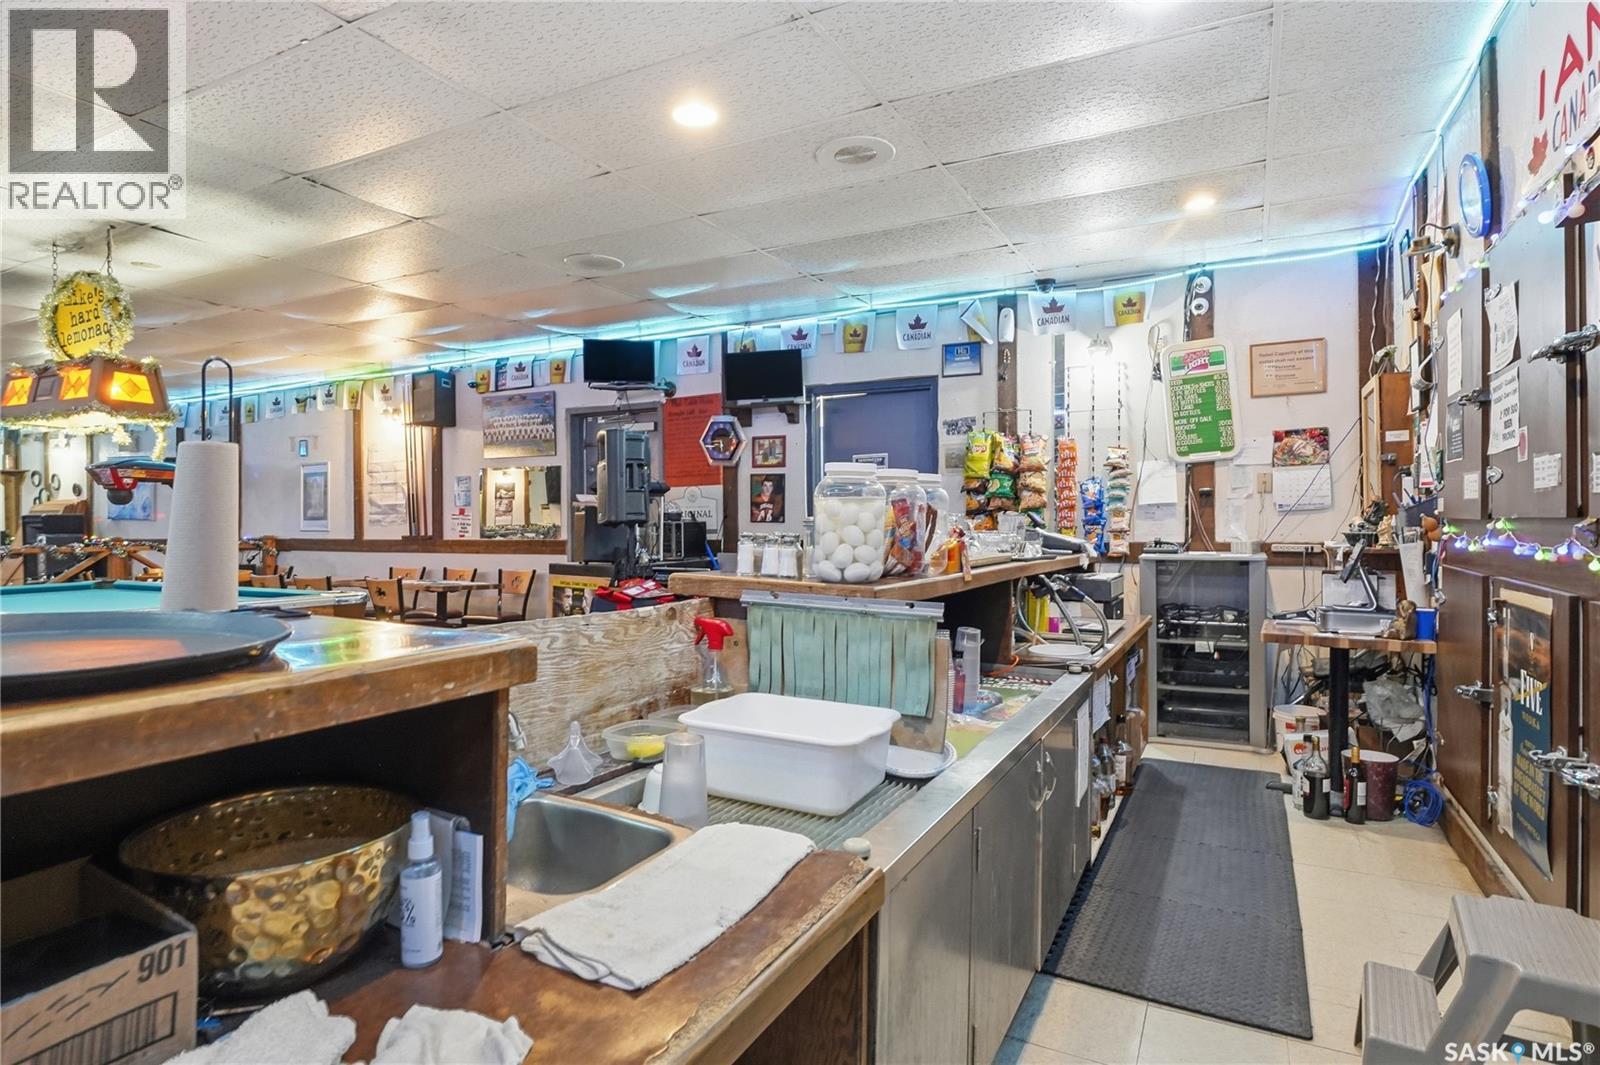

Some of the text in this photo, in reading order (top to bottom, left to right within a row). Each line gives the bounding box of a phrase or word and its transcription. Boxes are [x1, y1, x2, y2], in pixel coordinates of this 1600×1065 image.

[1539, 69, 1546, 121] I
[70, 304, 100, 328] hard
[1037, 314, 1070, 326] CANADIAN
[59, 322, 113, 349] lemonad
[903, 332, 932, 342] CANADIAN
[1520, 669, 1543, 716] FIVE
[137, 940, 188, 984] 901
